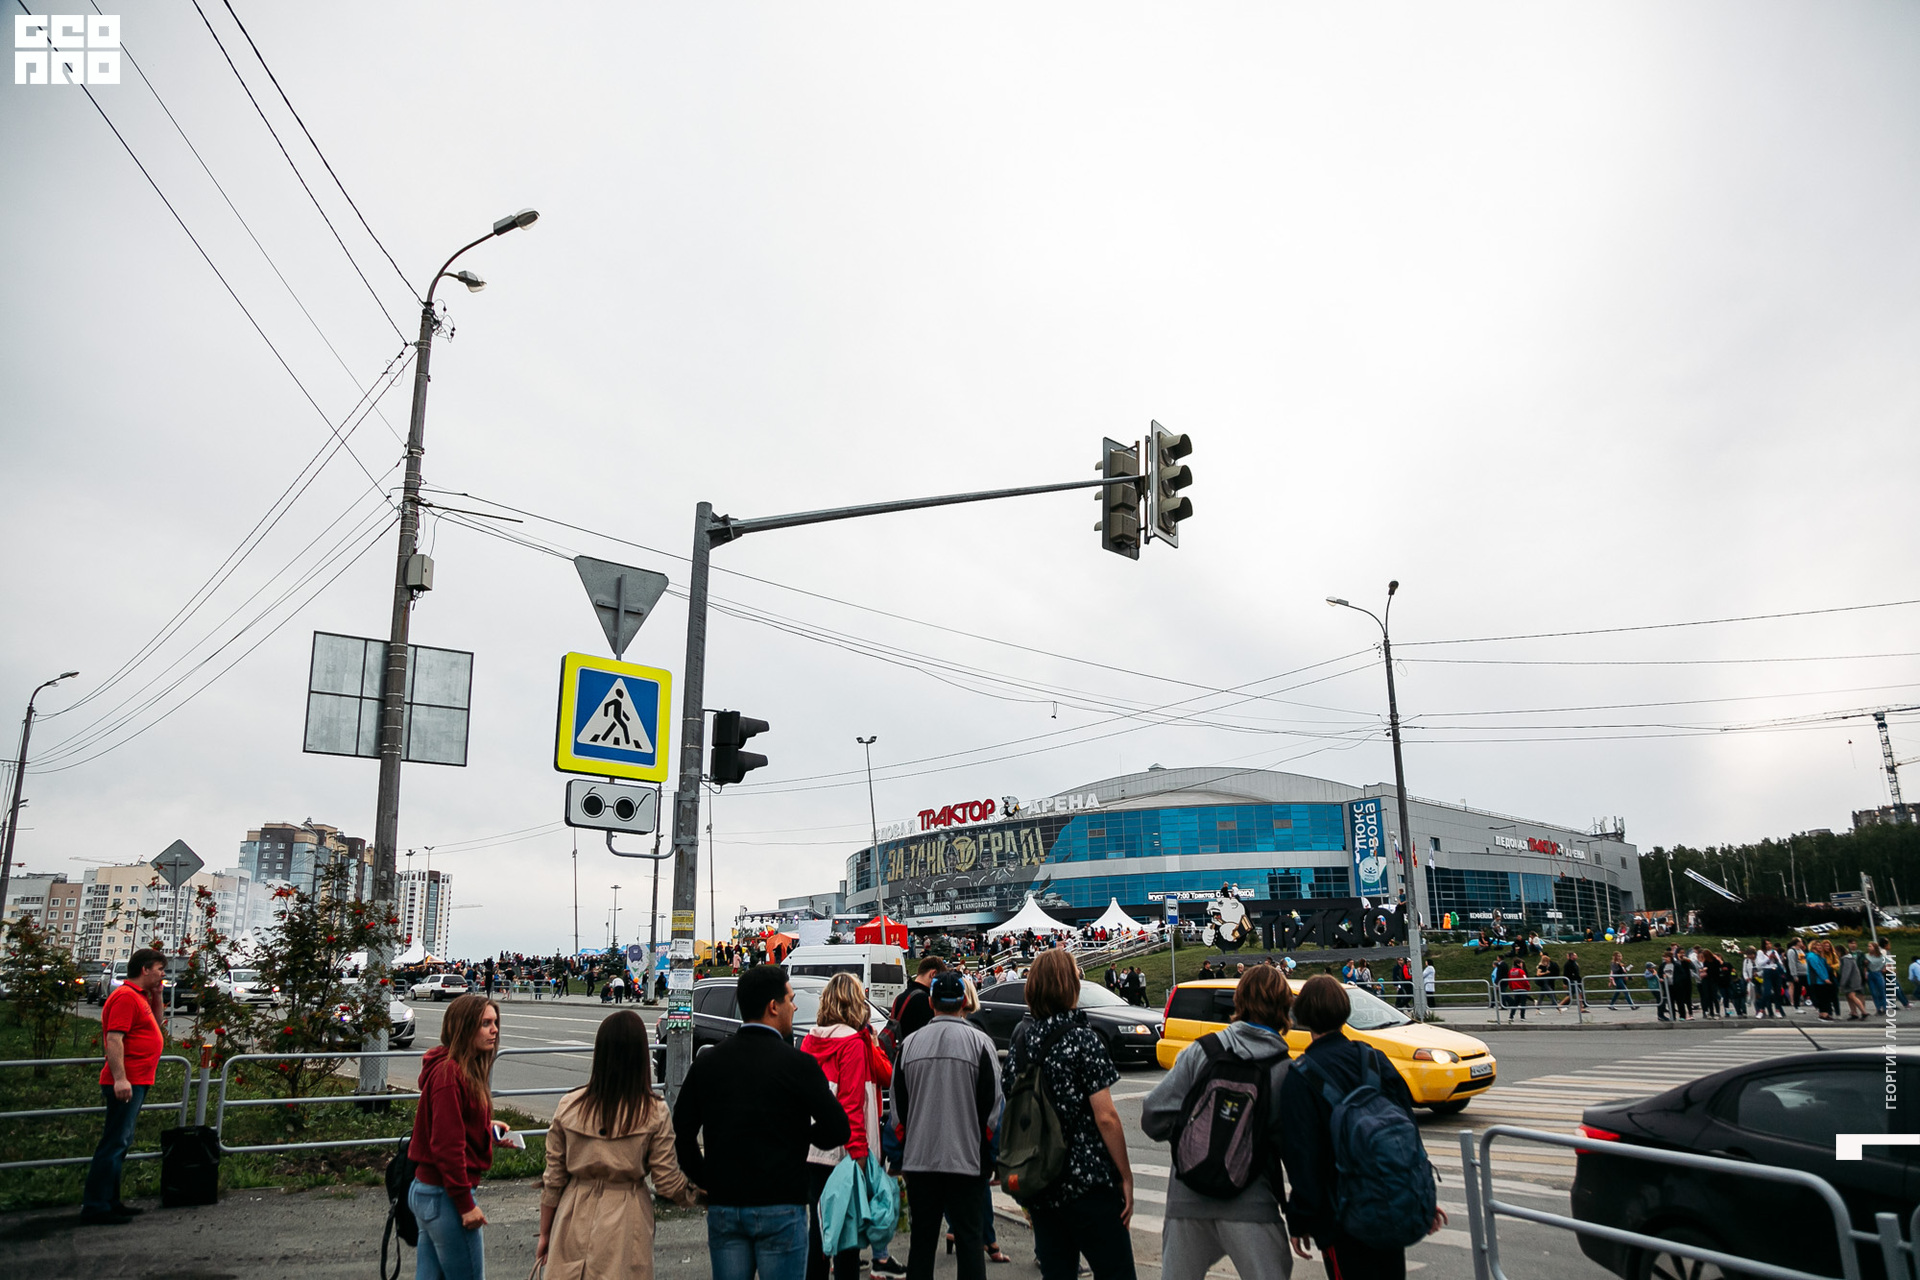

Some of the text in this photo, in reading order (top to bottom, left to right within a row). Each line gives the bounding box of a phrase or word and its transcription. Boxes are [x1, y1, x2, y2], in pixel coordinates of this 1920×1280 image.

[918, 799, 995, 831] ТРАКТОР
[1027, 793, 1099, 815] АРЕНА
[887, 848, 904, 882] ЗА
